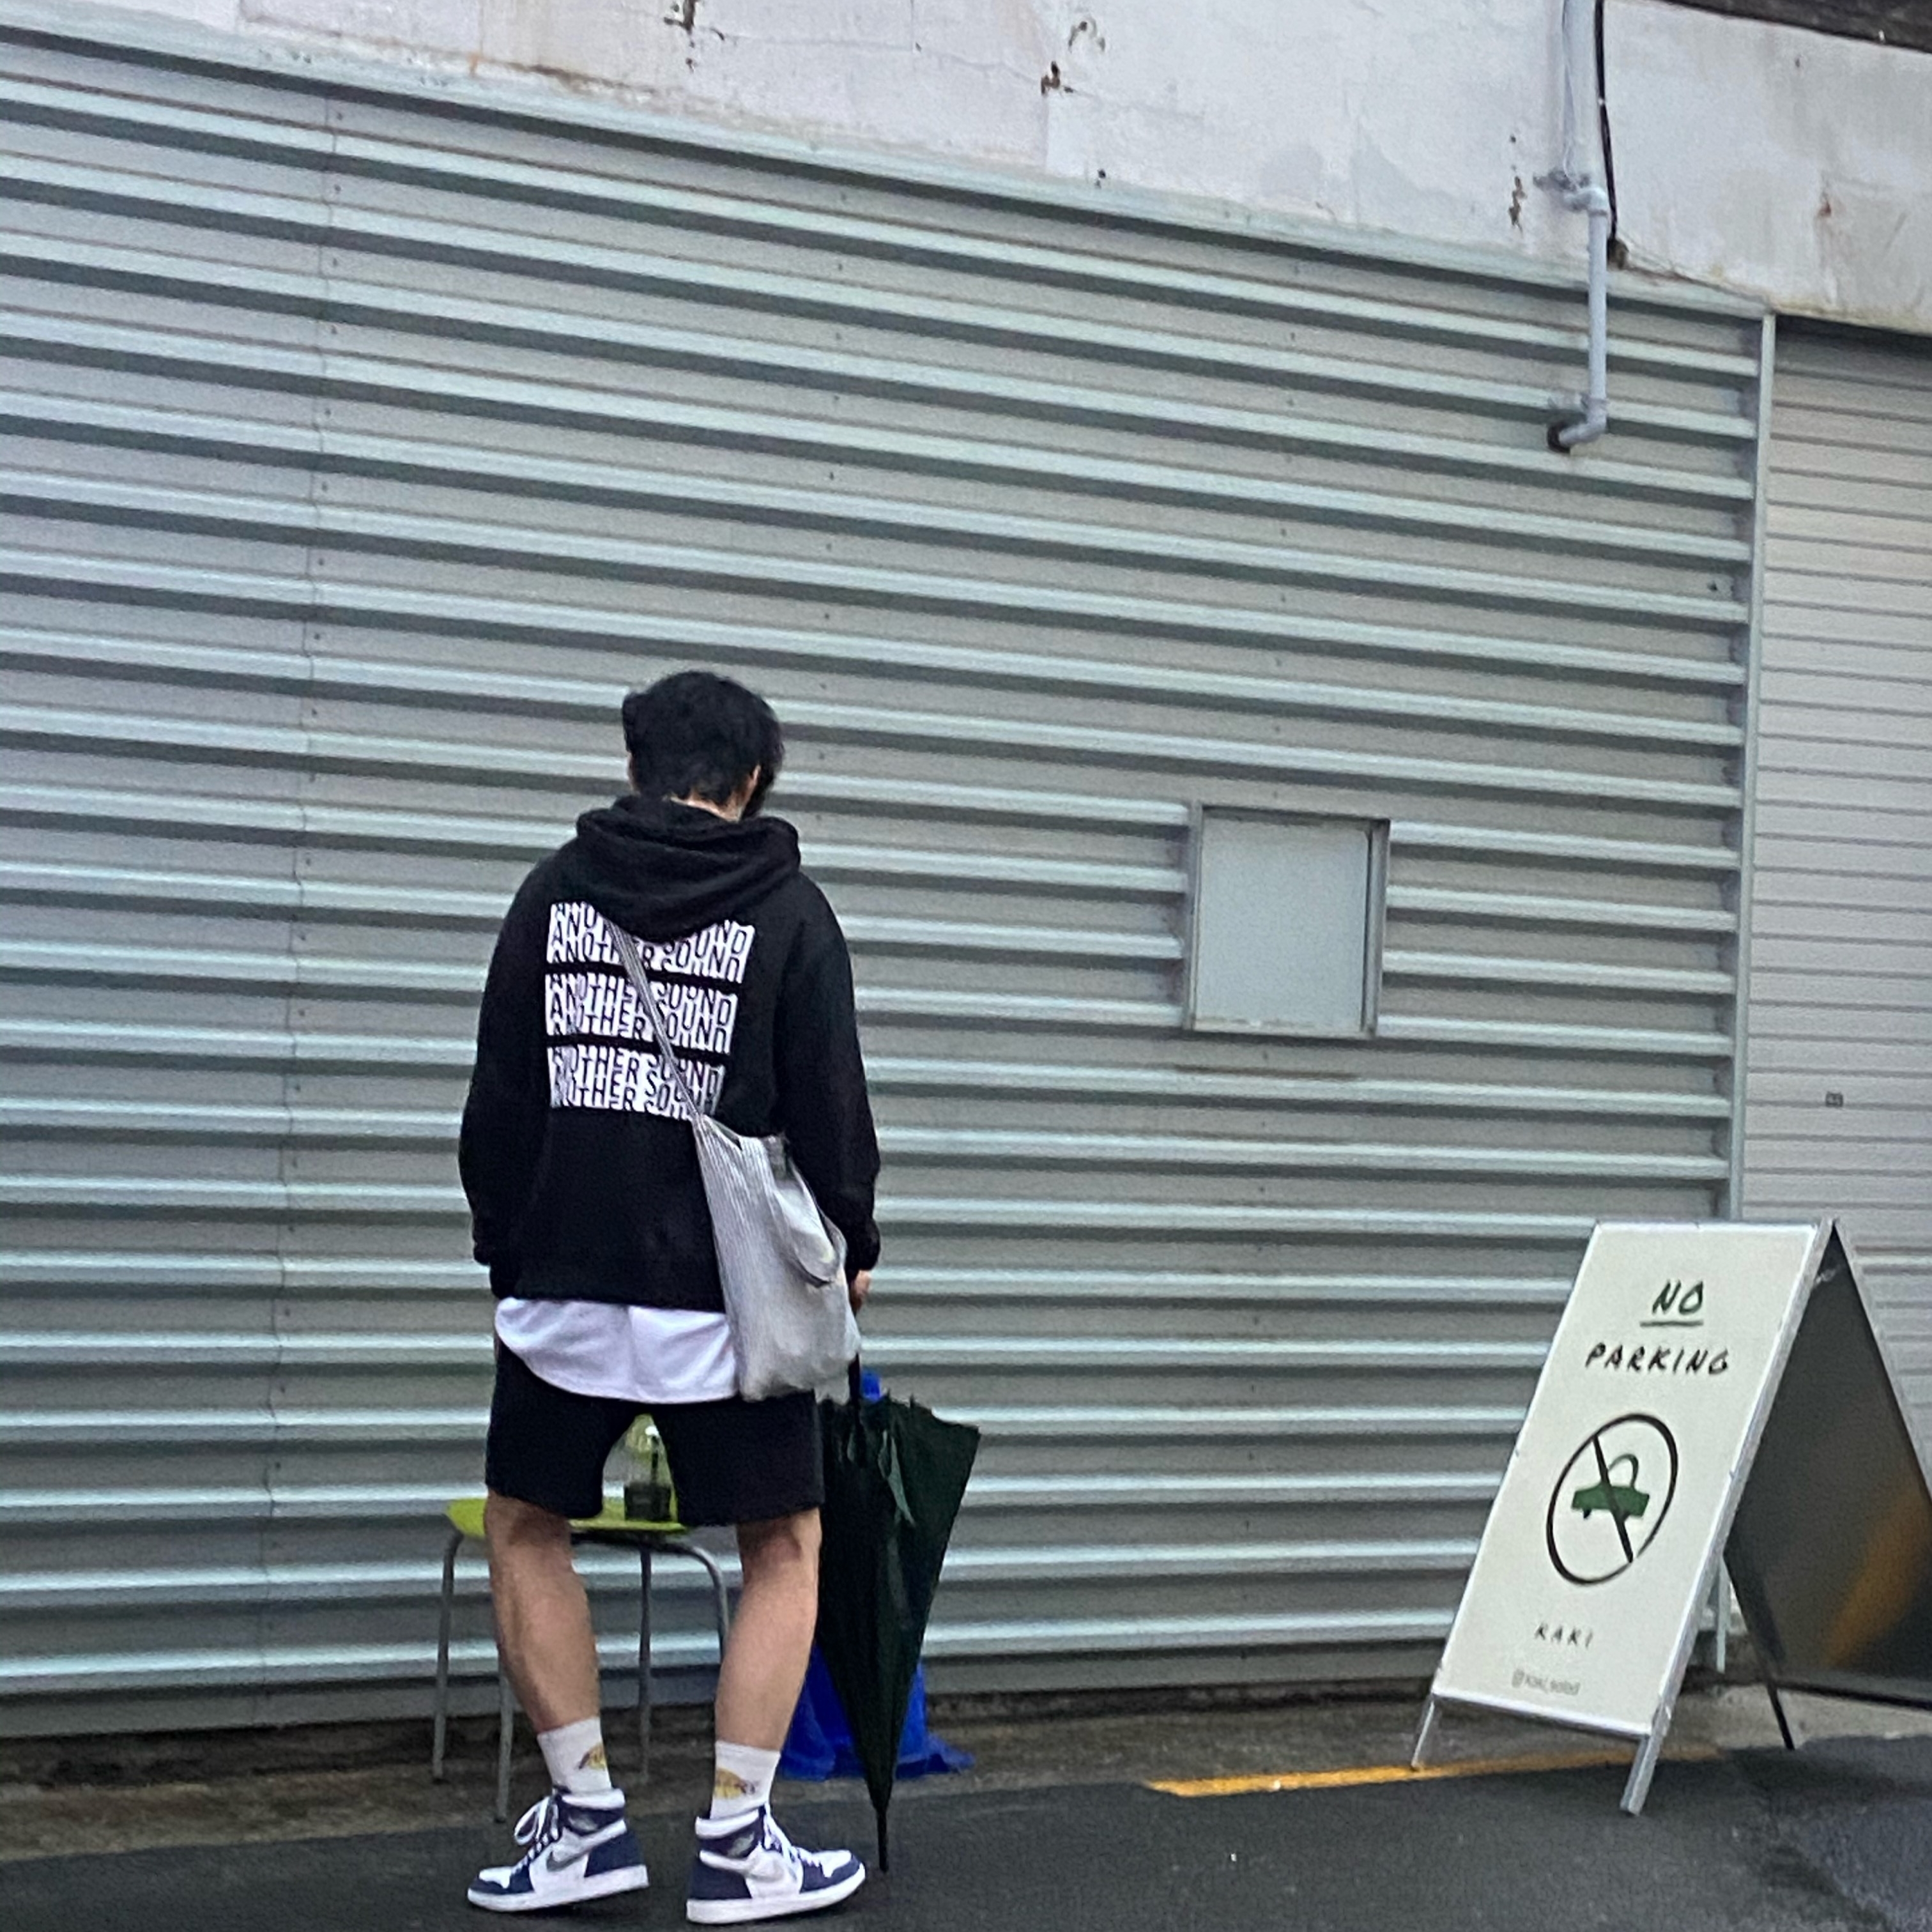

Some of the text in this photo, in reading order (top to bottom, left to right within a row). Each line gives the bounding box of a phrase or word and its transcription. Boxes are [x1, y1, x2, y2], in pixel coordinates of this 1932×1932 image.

[1652, 1279, 1704, 1315] NO
[1584, 1341, 1729, 1375] PARKING
[1534, 1622, 1593, 1649] KAKI
